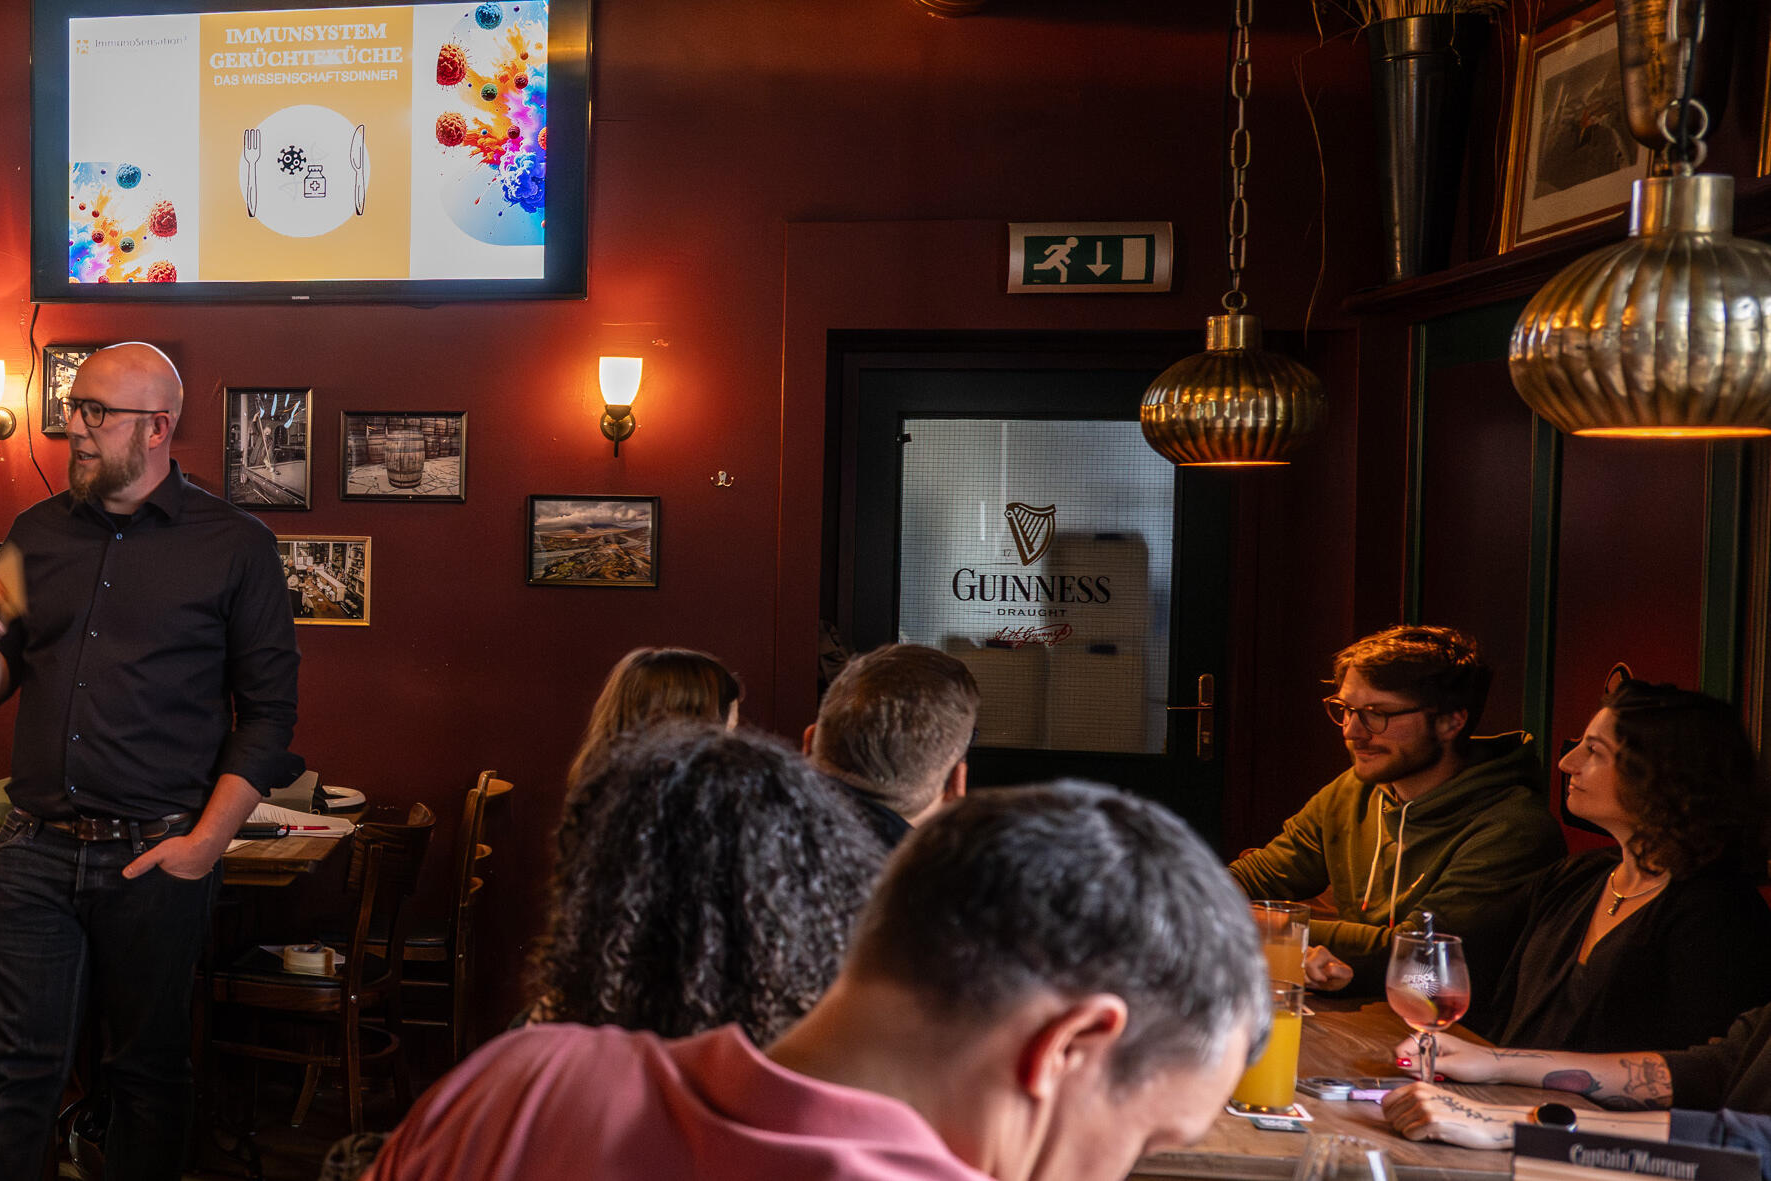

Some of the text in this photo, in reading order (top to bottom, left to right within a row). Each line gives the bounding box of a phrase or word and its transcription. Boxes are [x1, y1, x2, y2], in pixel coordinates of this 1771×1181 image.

[225, 23, 388, 44] IMMUNSYSTEM
[209, 45, 403, 69] GERÜCHTEKÜCHE
[214, 69, 398, 86] DAS WISSENSCHAFTSDINNER
[952, 567, 1111, 604] GUINNESS
[997, 608, 1067, 617] DRAUGHT
